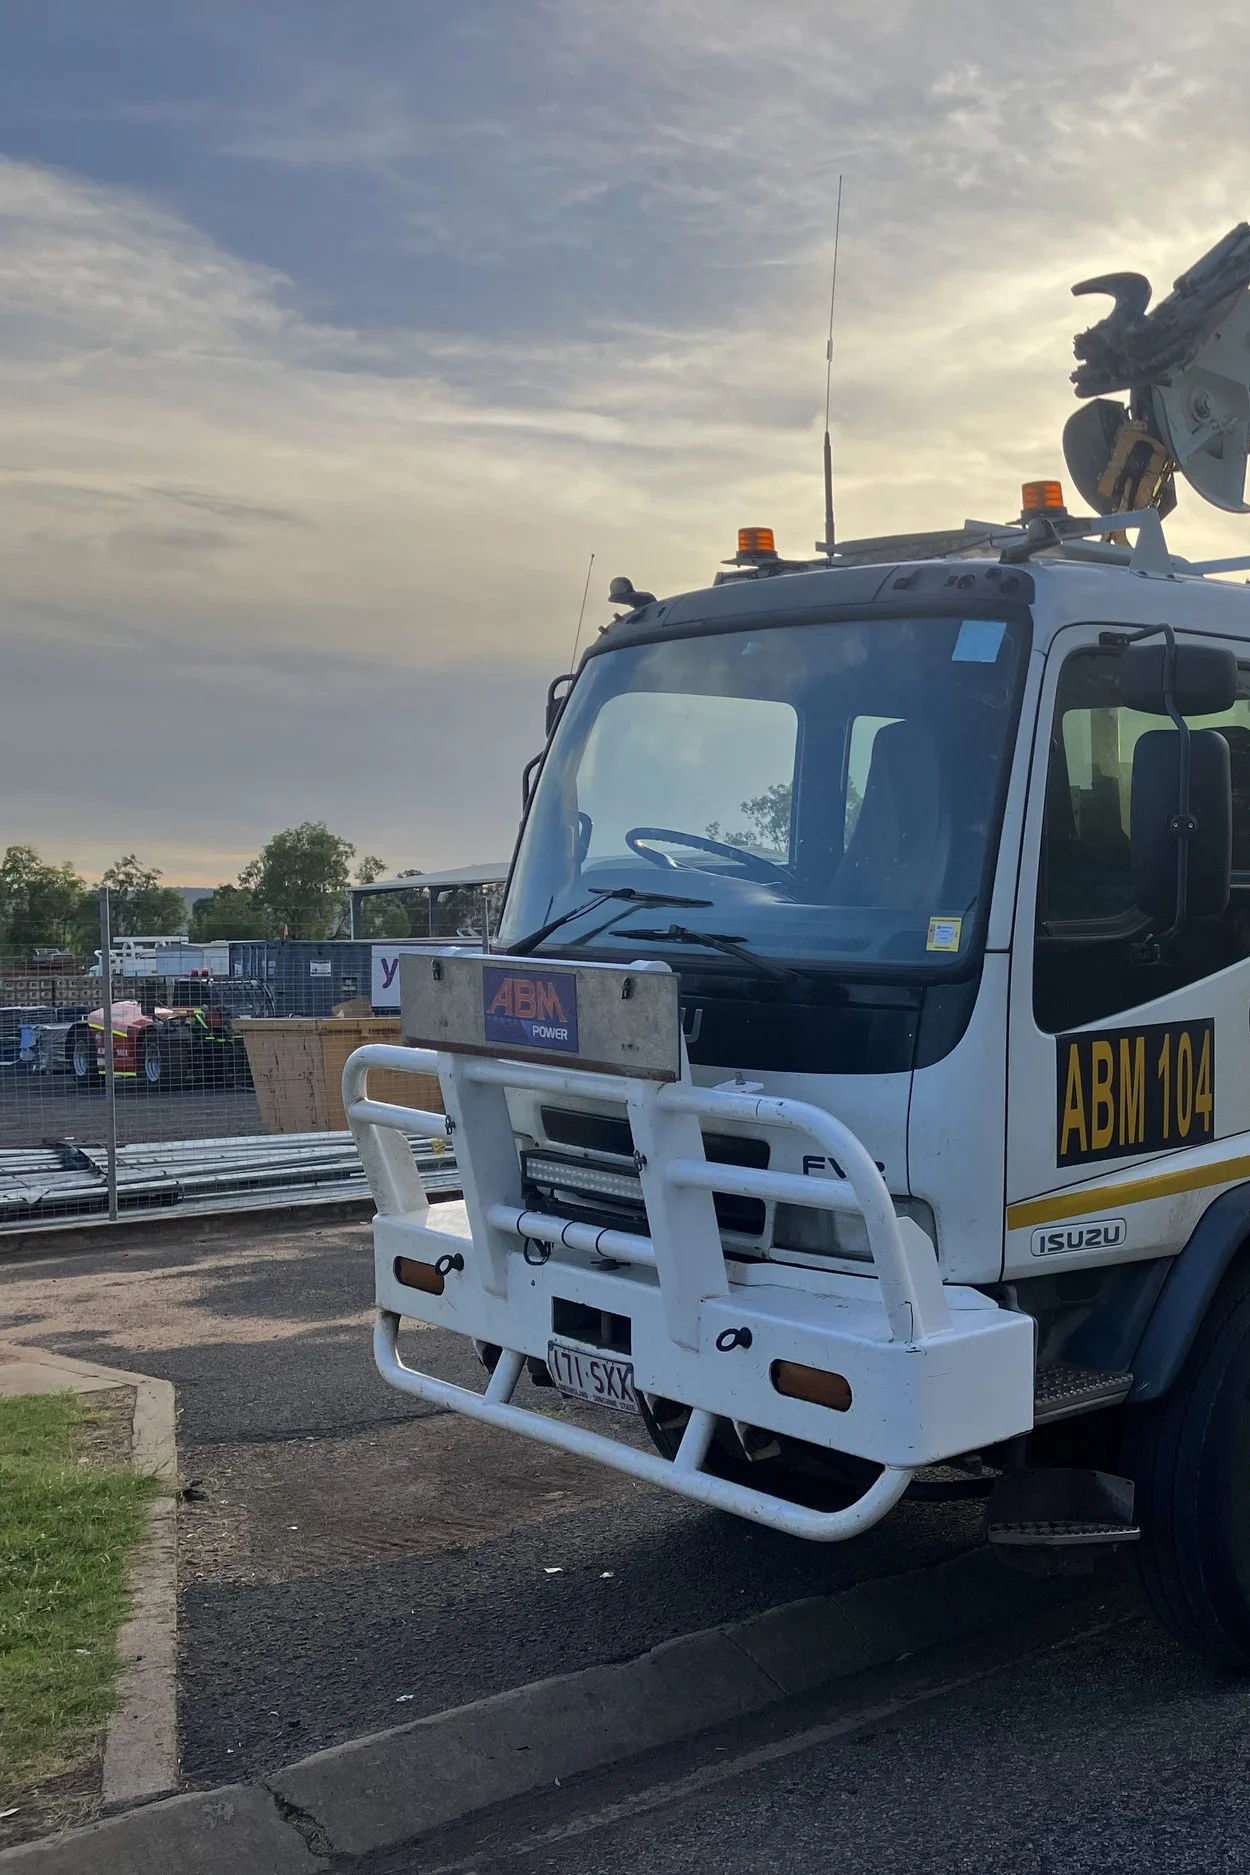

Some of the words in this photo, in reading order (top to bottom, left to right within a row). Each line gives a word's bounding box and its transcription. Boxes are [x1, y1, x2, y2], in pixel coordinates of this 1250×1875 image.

[486, 981, 569, 1024] ABM
[532, 1024, 569, 1042] POWER
[1060, 1036, 1145, 1155] ABM
[1158, 1029, 1213, 1139] 104
[1040, 1226, 1120, 1254] ISUZU
